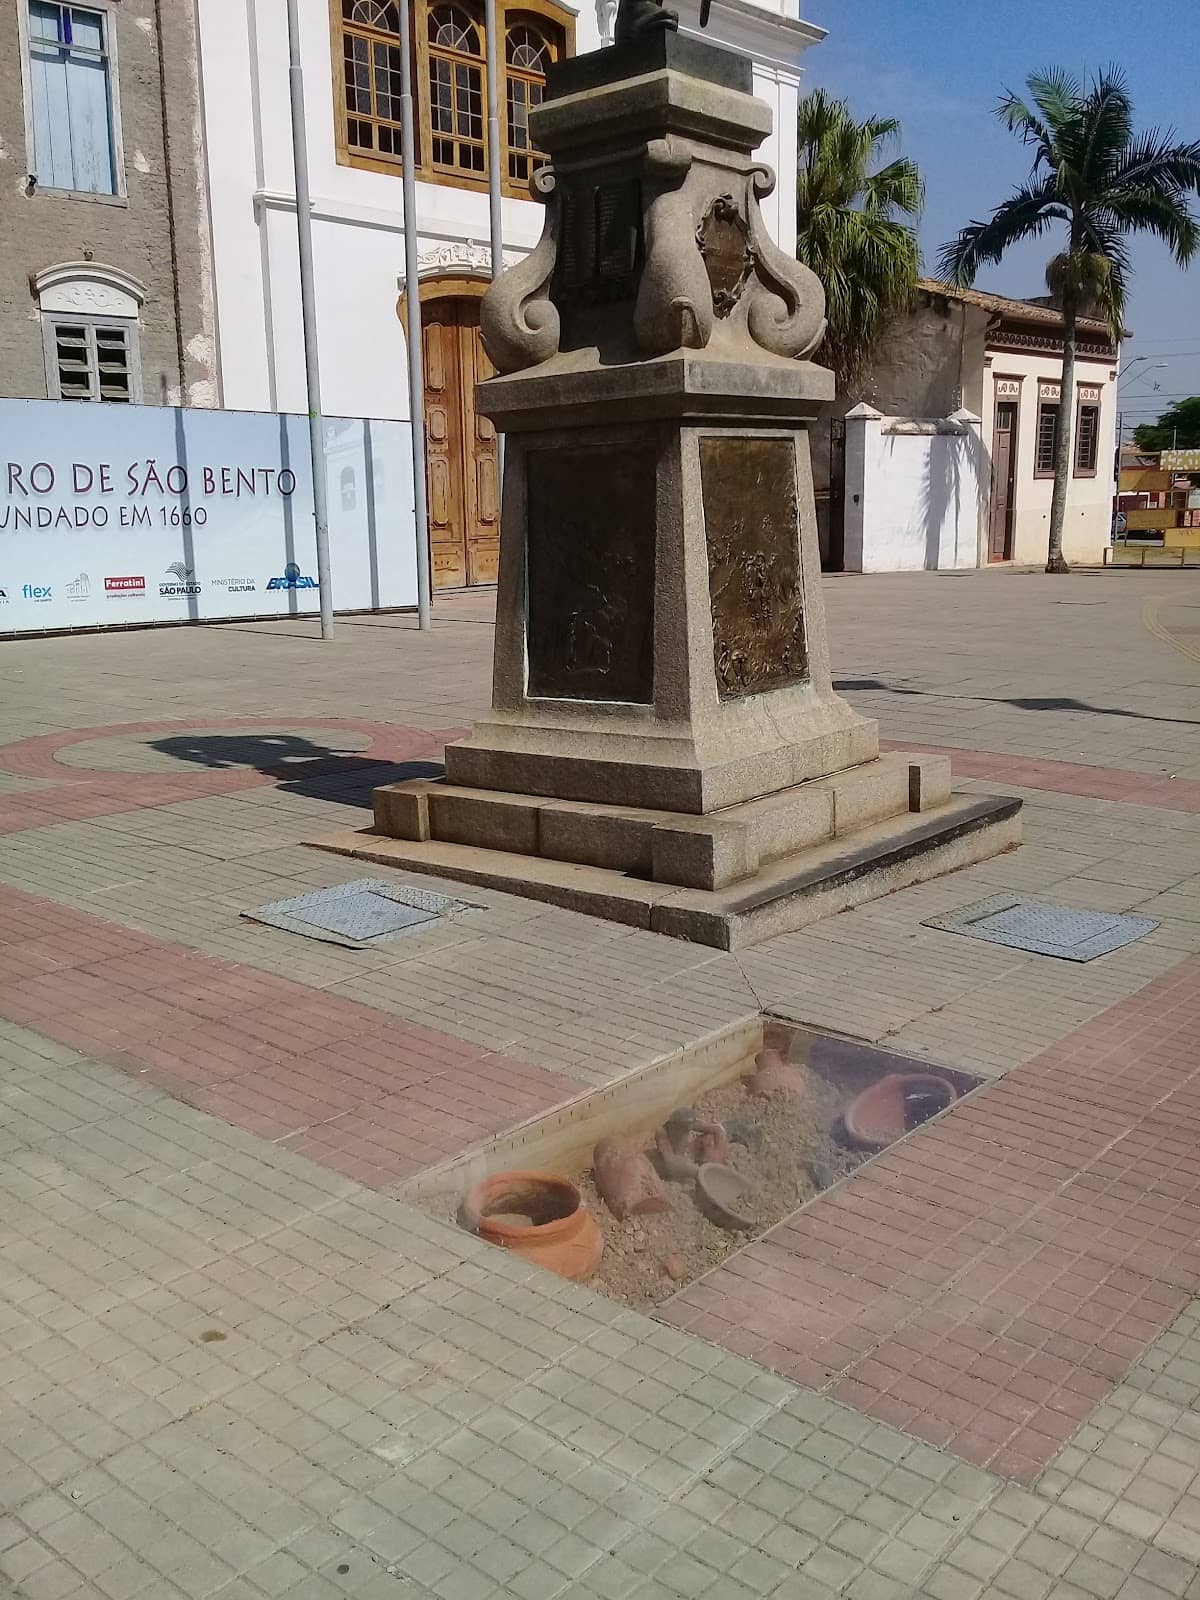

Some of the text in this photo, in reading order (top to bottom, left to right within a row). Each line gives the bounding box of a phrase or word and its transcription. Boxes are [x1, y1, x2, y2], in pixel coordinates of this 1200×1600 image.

[72, 463, 114, 493] DE
[128, 458, 188, 496] SÃO
[203, 466, 296, 497] BENTO
[120, 503, 152, 527] EM
[160, 505, 208, 527] 1660
[22, 584, 52, 599] flex
[159, 586, 202, 595] SÃO PAULO
